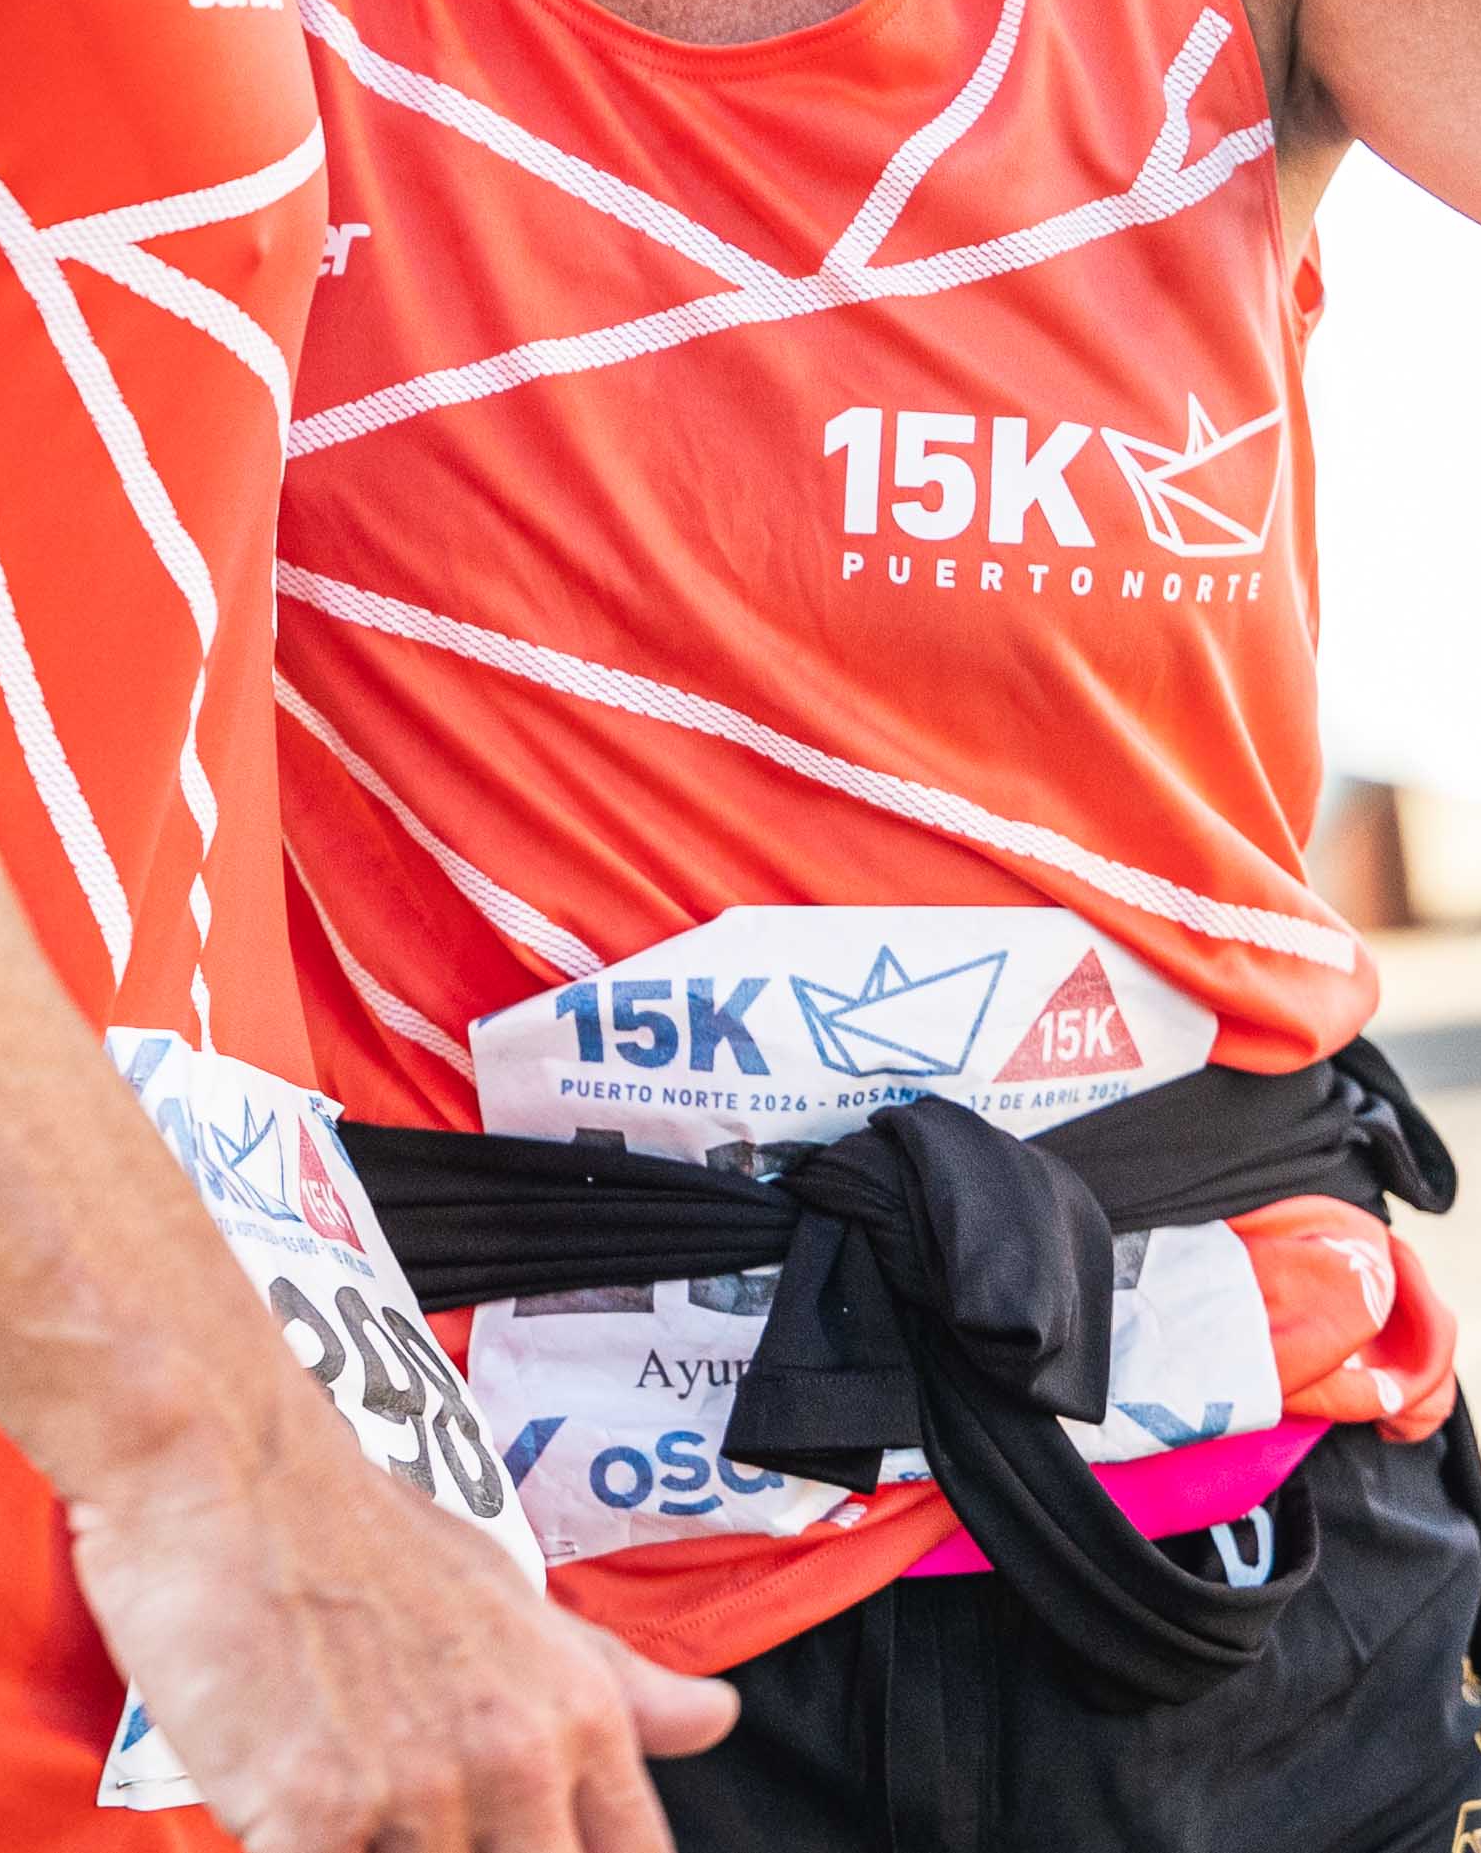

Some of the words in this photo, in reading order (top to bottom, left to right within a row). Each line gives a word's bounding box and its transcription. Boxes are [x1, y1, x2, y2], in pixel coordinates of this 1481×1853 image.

[823, 406, 1096, 548] 15K
[842, 551, 1093, 596] PUERTO
[1122, 569, 1263, 604] NORTE
[555, 977, 771, 1076] 15K
[1037, 1004, 1117, 1064] 15K
[560, 1078, 653, 1103] PUERTO
[662, 1086, 739, 1110] NORTE
[749, 1093, 808, 1112] 2026
[999, 1091, 1025, 1110] DE
[1030, 1086, 1080, 1109] ABRIL
